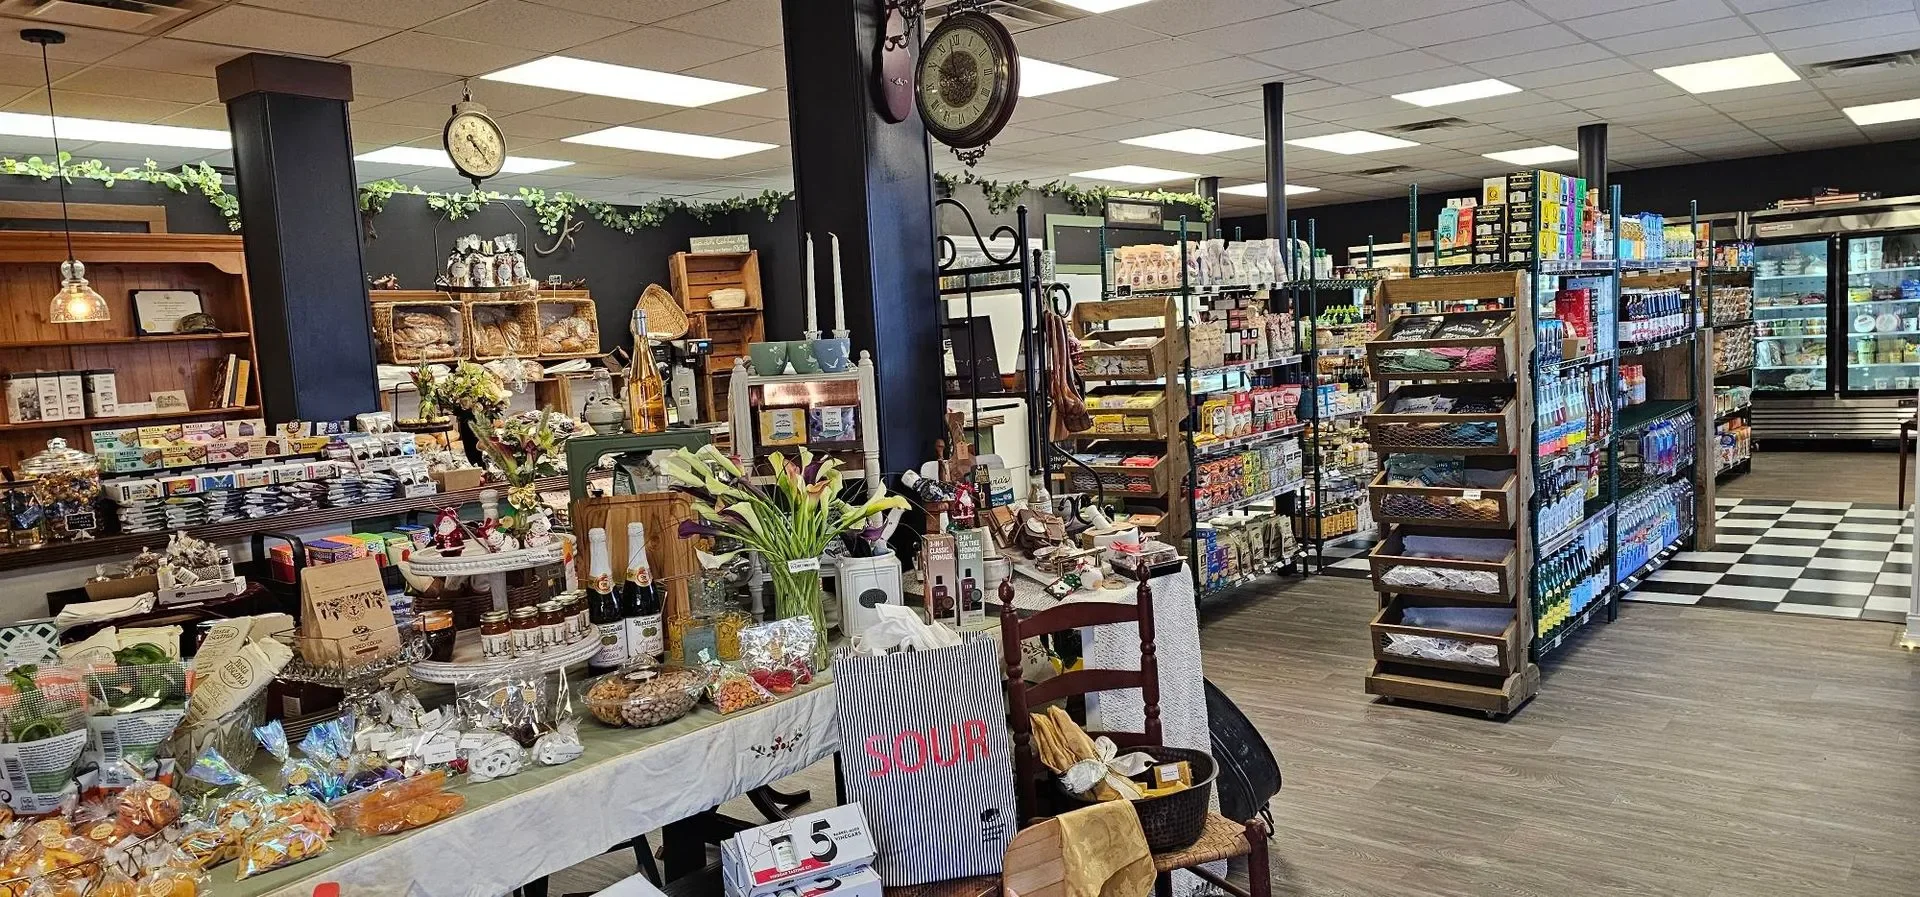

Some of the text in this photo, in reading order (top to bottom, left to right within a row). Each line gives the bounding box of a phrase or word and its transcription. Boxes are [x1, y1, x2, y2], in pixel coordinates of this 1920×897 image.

[482, 240, 494, 255] M
[864, 720, 990, 778] SOUR
[810, 819, 837, 862] 5
[835, 830, 862, 841] VINEGARS
